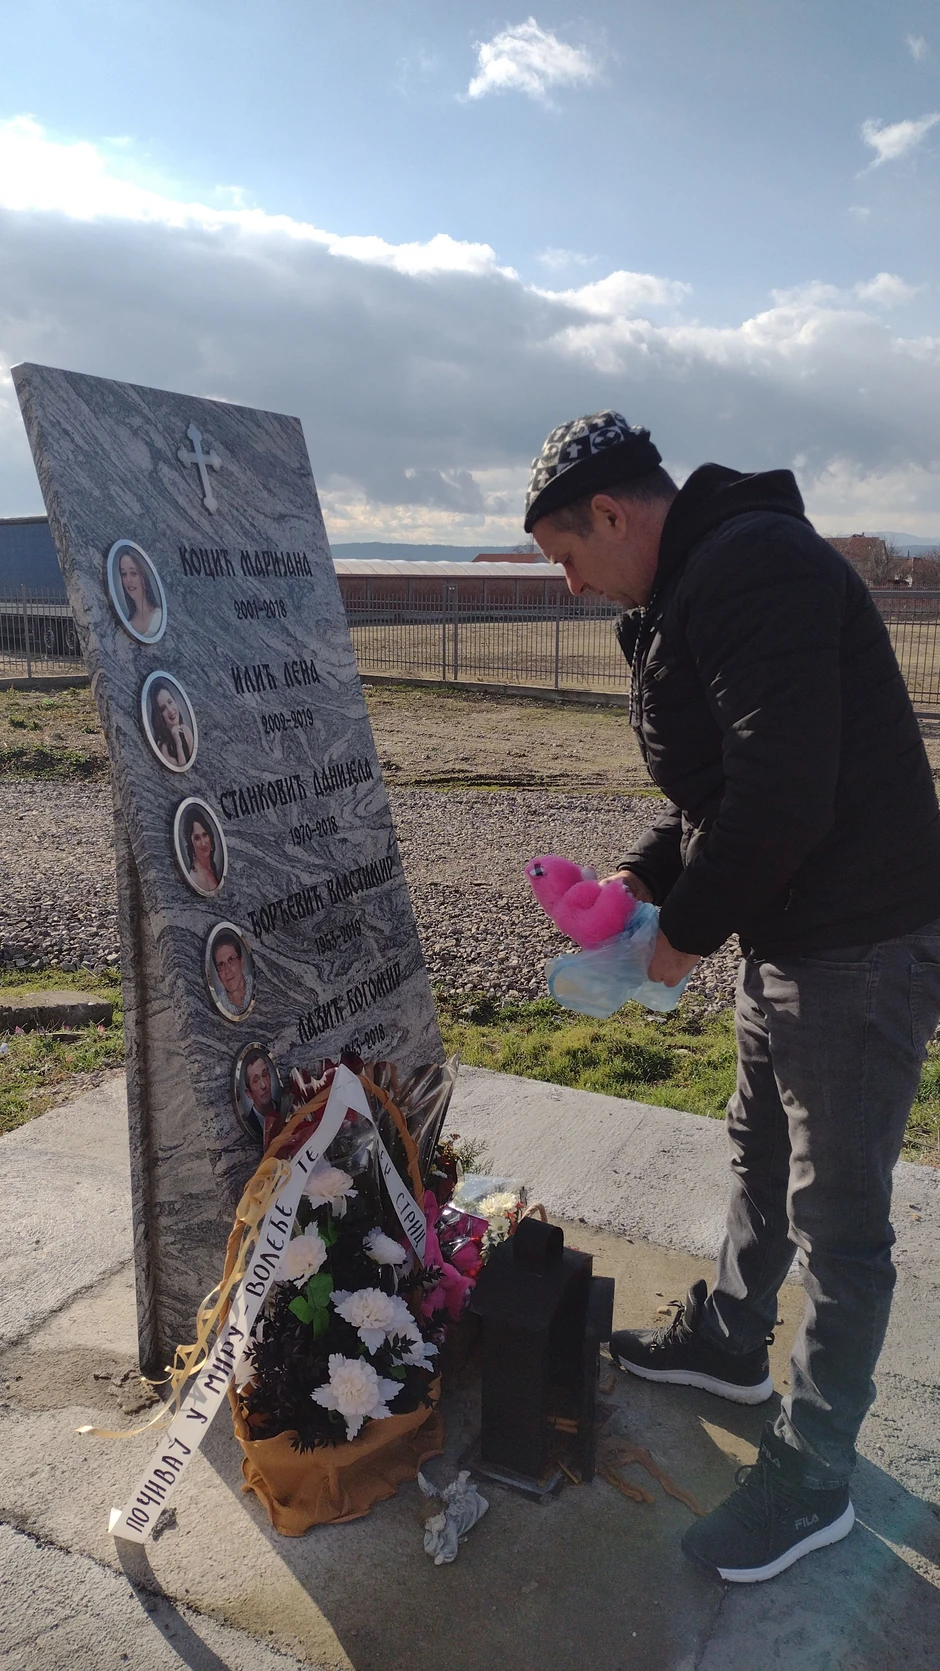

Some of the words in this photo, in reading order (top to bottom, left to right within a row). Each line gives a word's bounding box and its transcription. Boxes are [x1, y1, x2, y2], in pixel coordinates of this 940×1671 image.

[178, 546, 236, 581] КОЦИЋ
[240, 550, 313, 577] МАРИЈАНА
[233, 599, 288, 620] 2001-2018
[230, 663, 277, 694] ИЛИЋ
[283, 659, 321, 688] ЛЕНА
[261, 707, 314, 734] 2002-2019
[220, 774, 307, 820] СТАНКОВИЋ
[313, 757, 374, 798] ДАНИЈЕЛА
[289, 815, 338, 847] 1970-2018
[326, 856, 393, 905] ВЛАСТИМИР
[299, 996, 345, 1044] ЛАЗИЋ
[346, 962, 401, 1017] БОГОМИР
[125, 1437, 192, 1534] ПОЧИВАЈ
[186, 1407, 208, 1424] У
[295, 1146, 319, 1174] ТЕ
[794, 1513, 819, 1531] FILA
